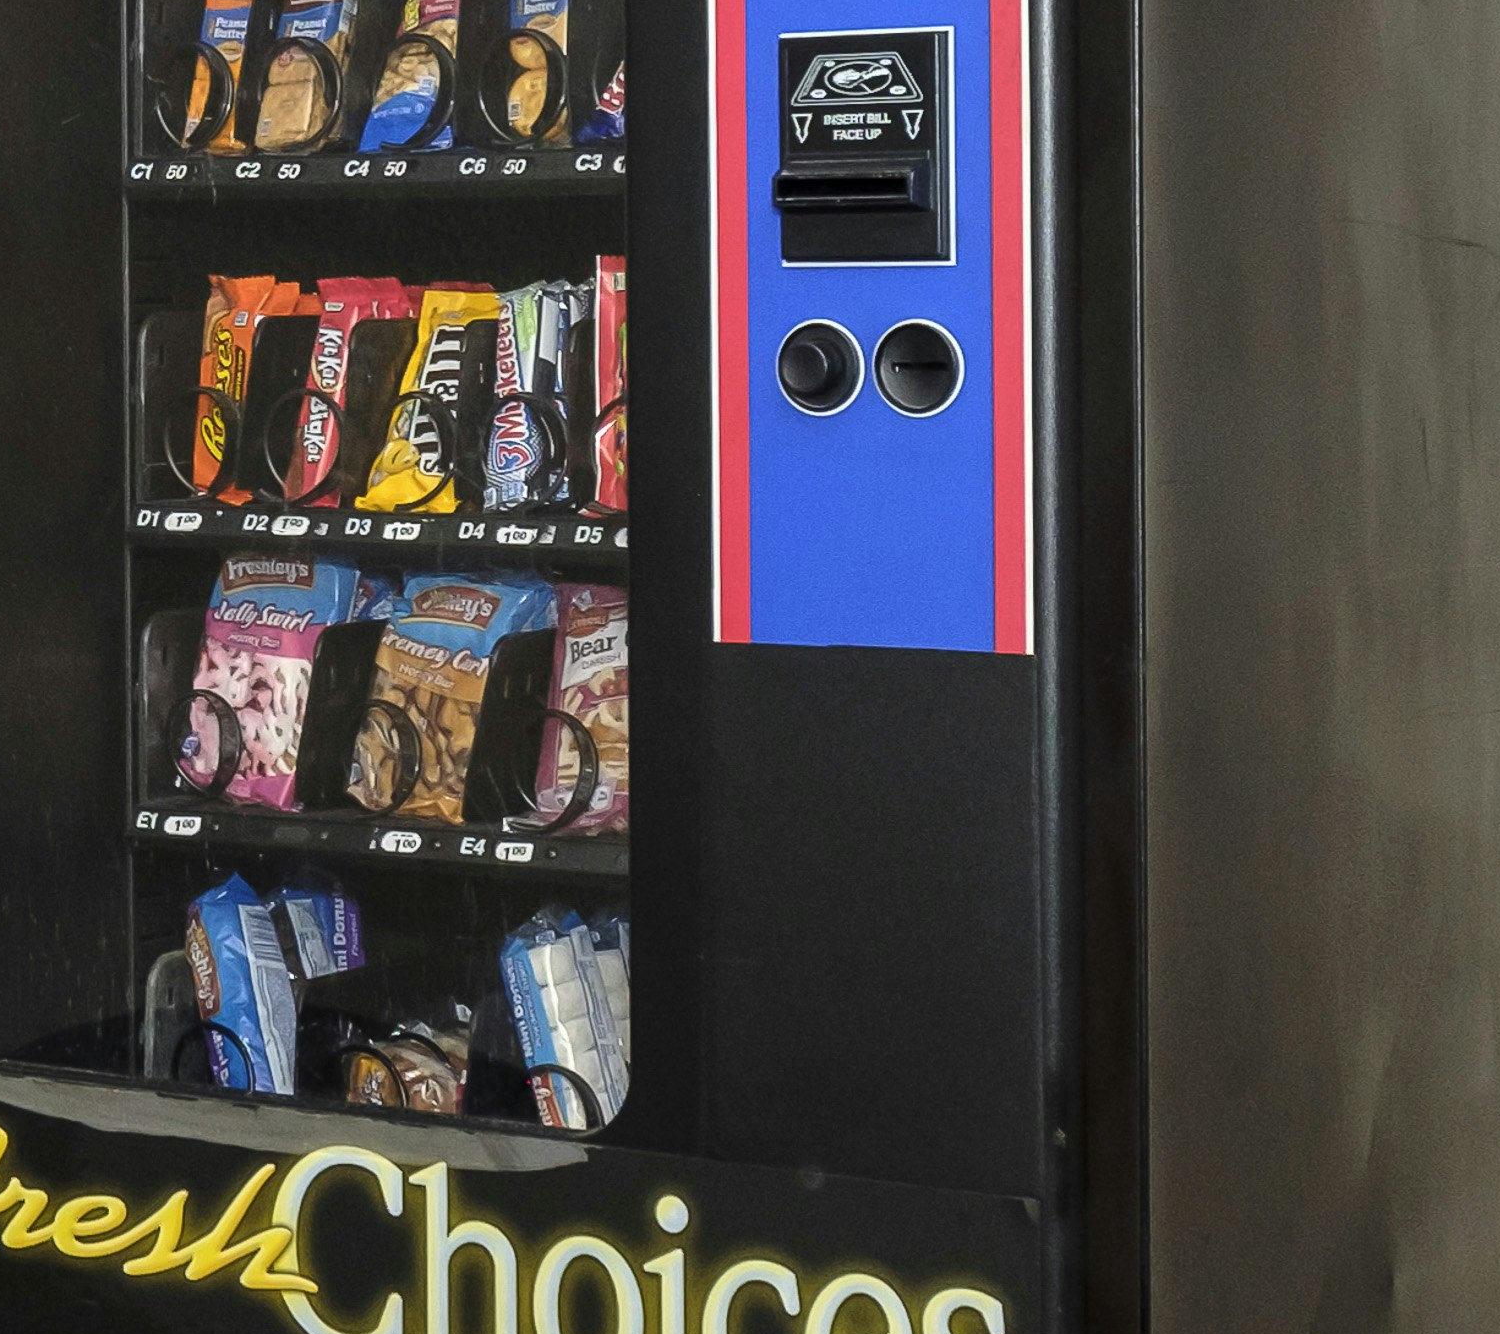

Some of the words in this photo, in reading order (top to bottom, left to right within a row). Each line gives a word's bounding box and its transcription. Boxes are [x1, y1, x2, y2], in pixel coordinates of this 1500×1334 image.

[524, 1, 557, 15] Butter
[216, 17, 248, 28] Peanu
[823, 113, 866, 126] INSERT
[866, 113, 892, 124] BILL
[833, 129, 864, 141] FACE
[865, 128, 882, 140] UP
[130, 163, 154, 180] C1
[235, 161, 262, 178] C2
[278, 163, 301, 180] 50
[344, 160, 370, 177] C4
[383, 160, 407, 177] 50
[459, 157, 487, 175] C6
[503, 158, 527, 175] 50
[575, 153, 603, 171] C3
[495, 442, 534, 472] 3
[136, 509, 161, 527] D1
[242, 514, 270, 531] D2
[344, 517, 372, 536] D3
[458, 521, 486, 540] D4
[574, 525, 604, 545] D5
[213, 600, 258, 629] Jelly
[257, 604, 315, 633] Swirl
[570, 636, 618, 664] Bear
[135, 811, 159, 830] E1
[459, 836, 487, 856] E4
